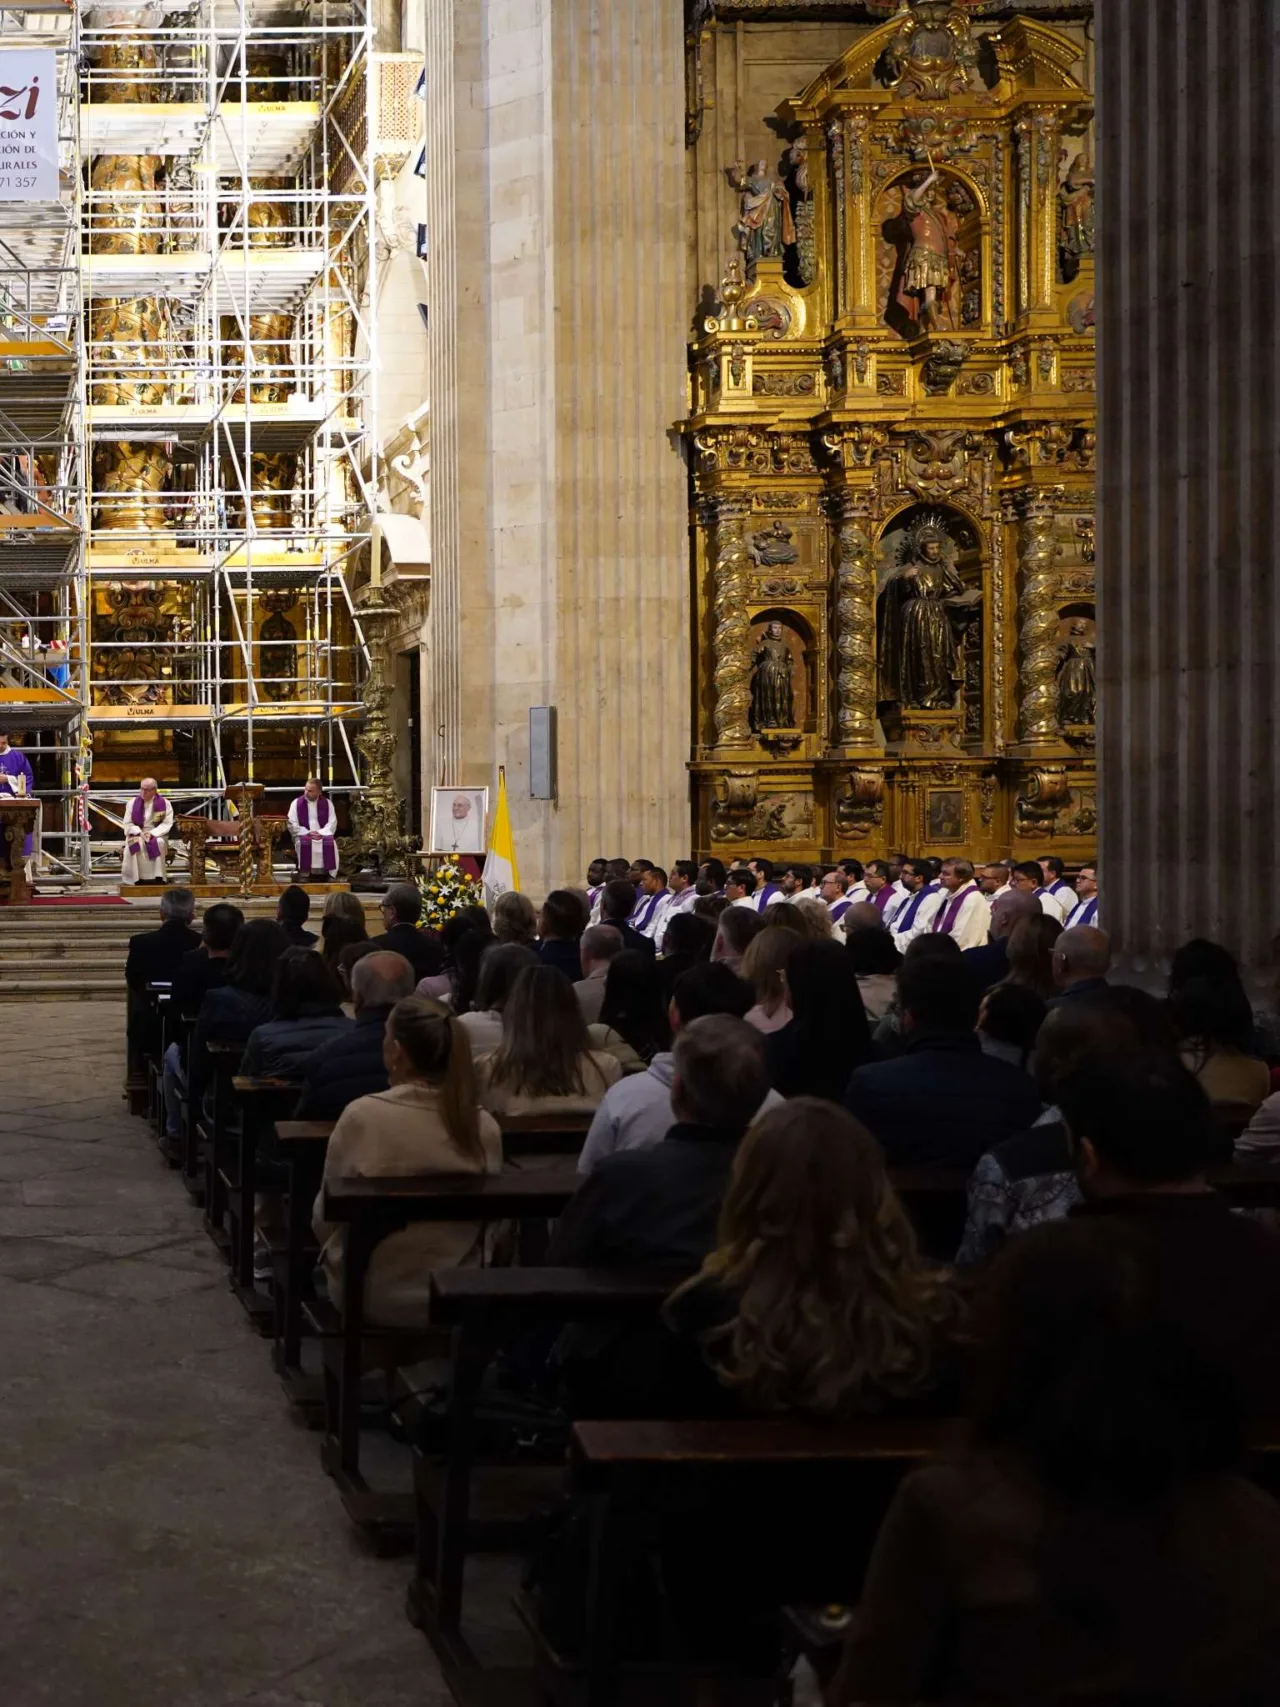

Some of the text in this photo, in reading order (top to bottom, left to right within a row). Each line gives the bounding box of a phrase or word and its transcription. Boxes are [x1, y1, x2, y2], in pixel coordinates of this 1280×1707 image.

[29, 130, 37, 139] Y
[23, 145, 36, 154] DE
[14, 176, 37, 188] 357
